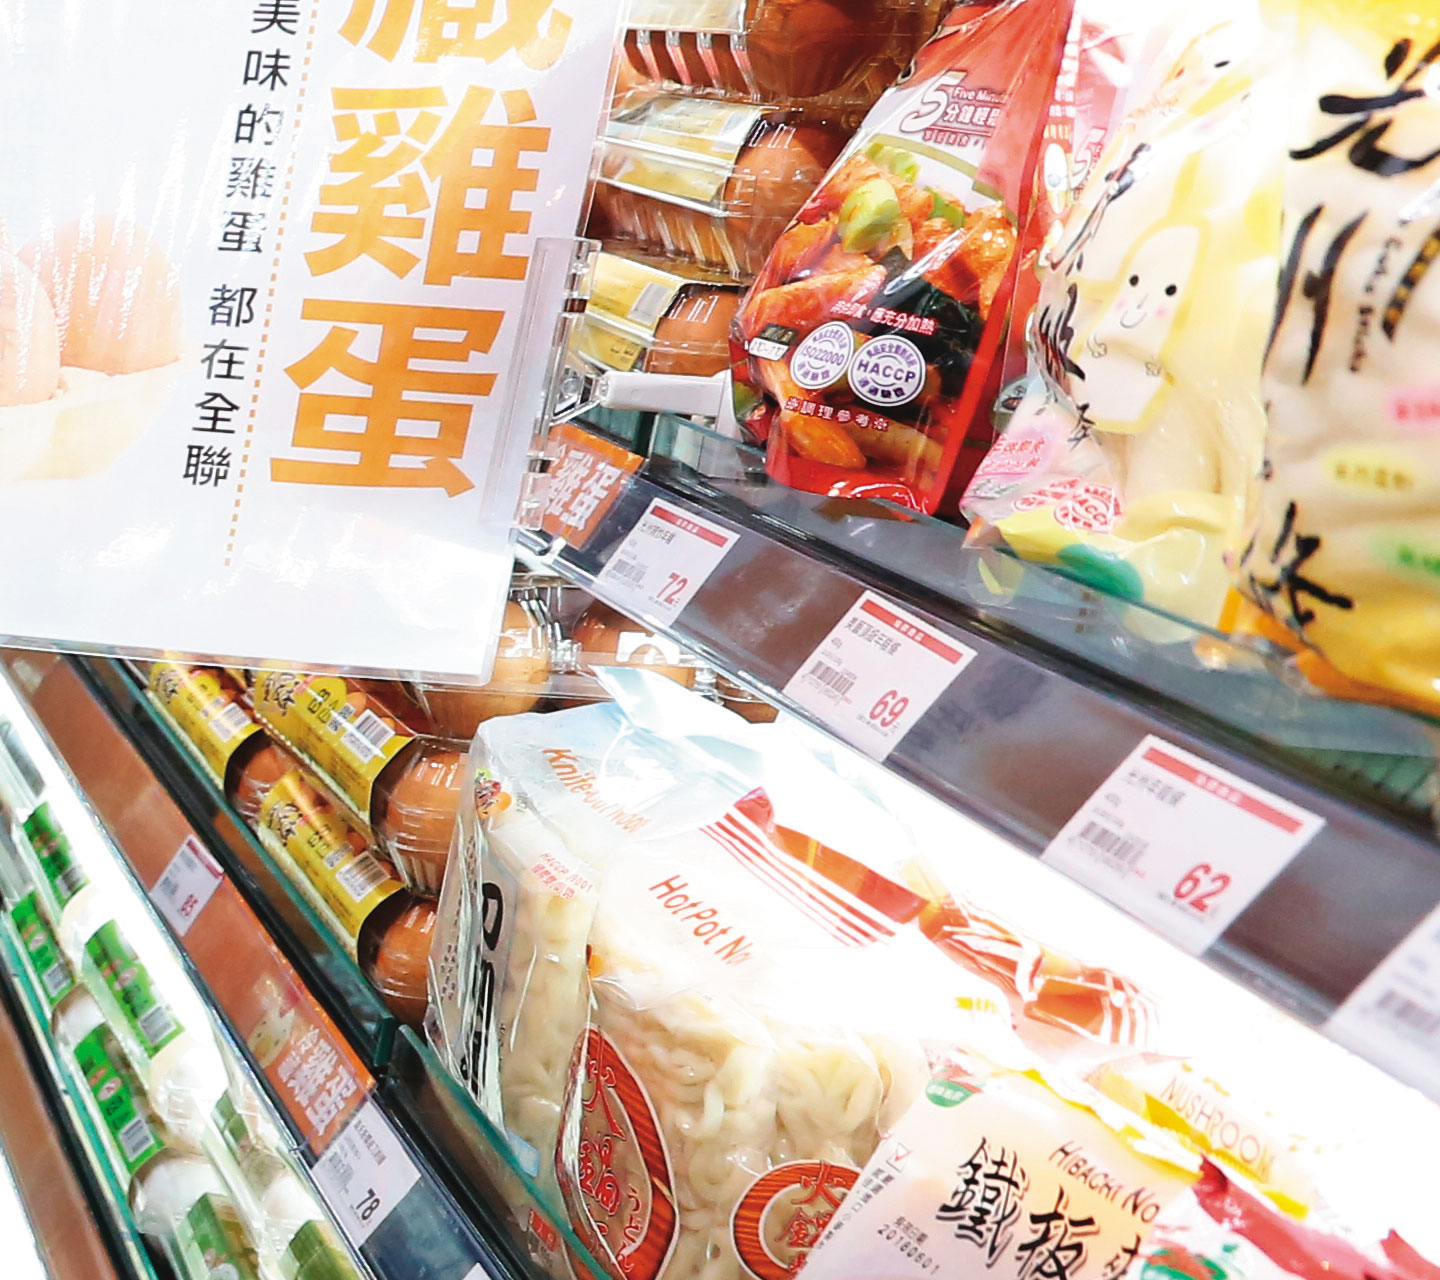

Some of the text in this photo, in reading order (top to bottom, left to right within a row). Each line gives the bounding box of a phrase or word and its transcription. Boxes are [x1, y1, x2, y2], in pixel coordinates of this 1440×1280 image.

[898, 70, 969, 133] 5
[953, 85, 976, 102] Five
[799, 348, 846, 370] ISO22000
[856, 358, 917, 386] HACCP
[182, 283, 257, 488] 都在全聯
[656, 572, 687, 602] 72
[868, 689, 910, 728] 69
[648, 873, 690, 915] Hot
[682, 905, 725, 948] Pot
[1173, 861, 1232, 915] 62
[1160, 1076, 1277, 1187] MUSHROOM
[1048, 1140, 1123, 1201] HIBACHI
[353, 1194, 381, 1224] 78
